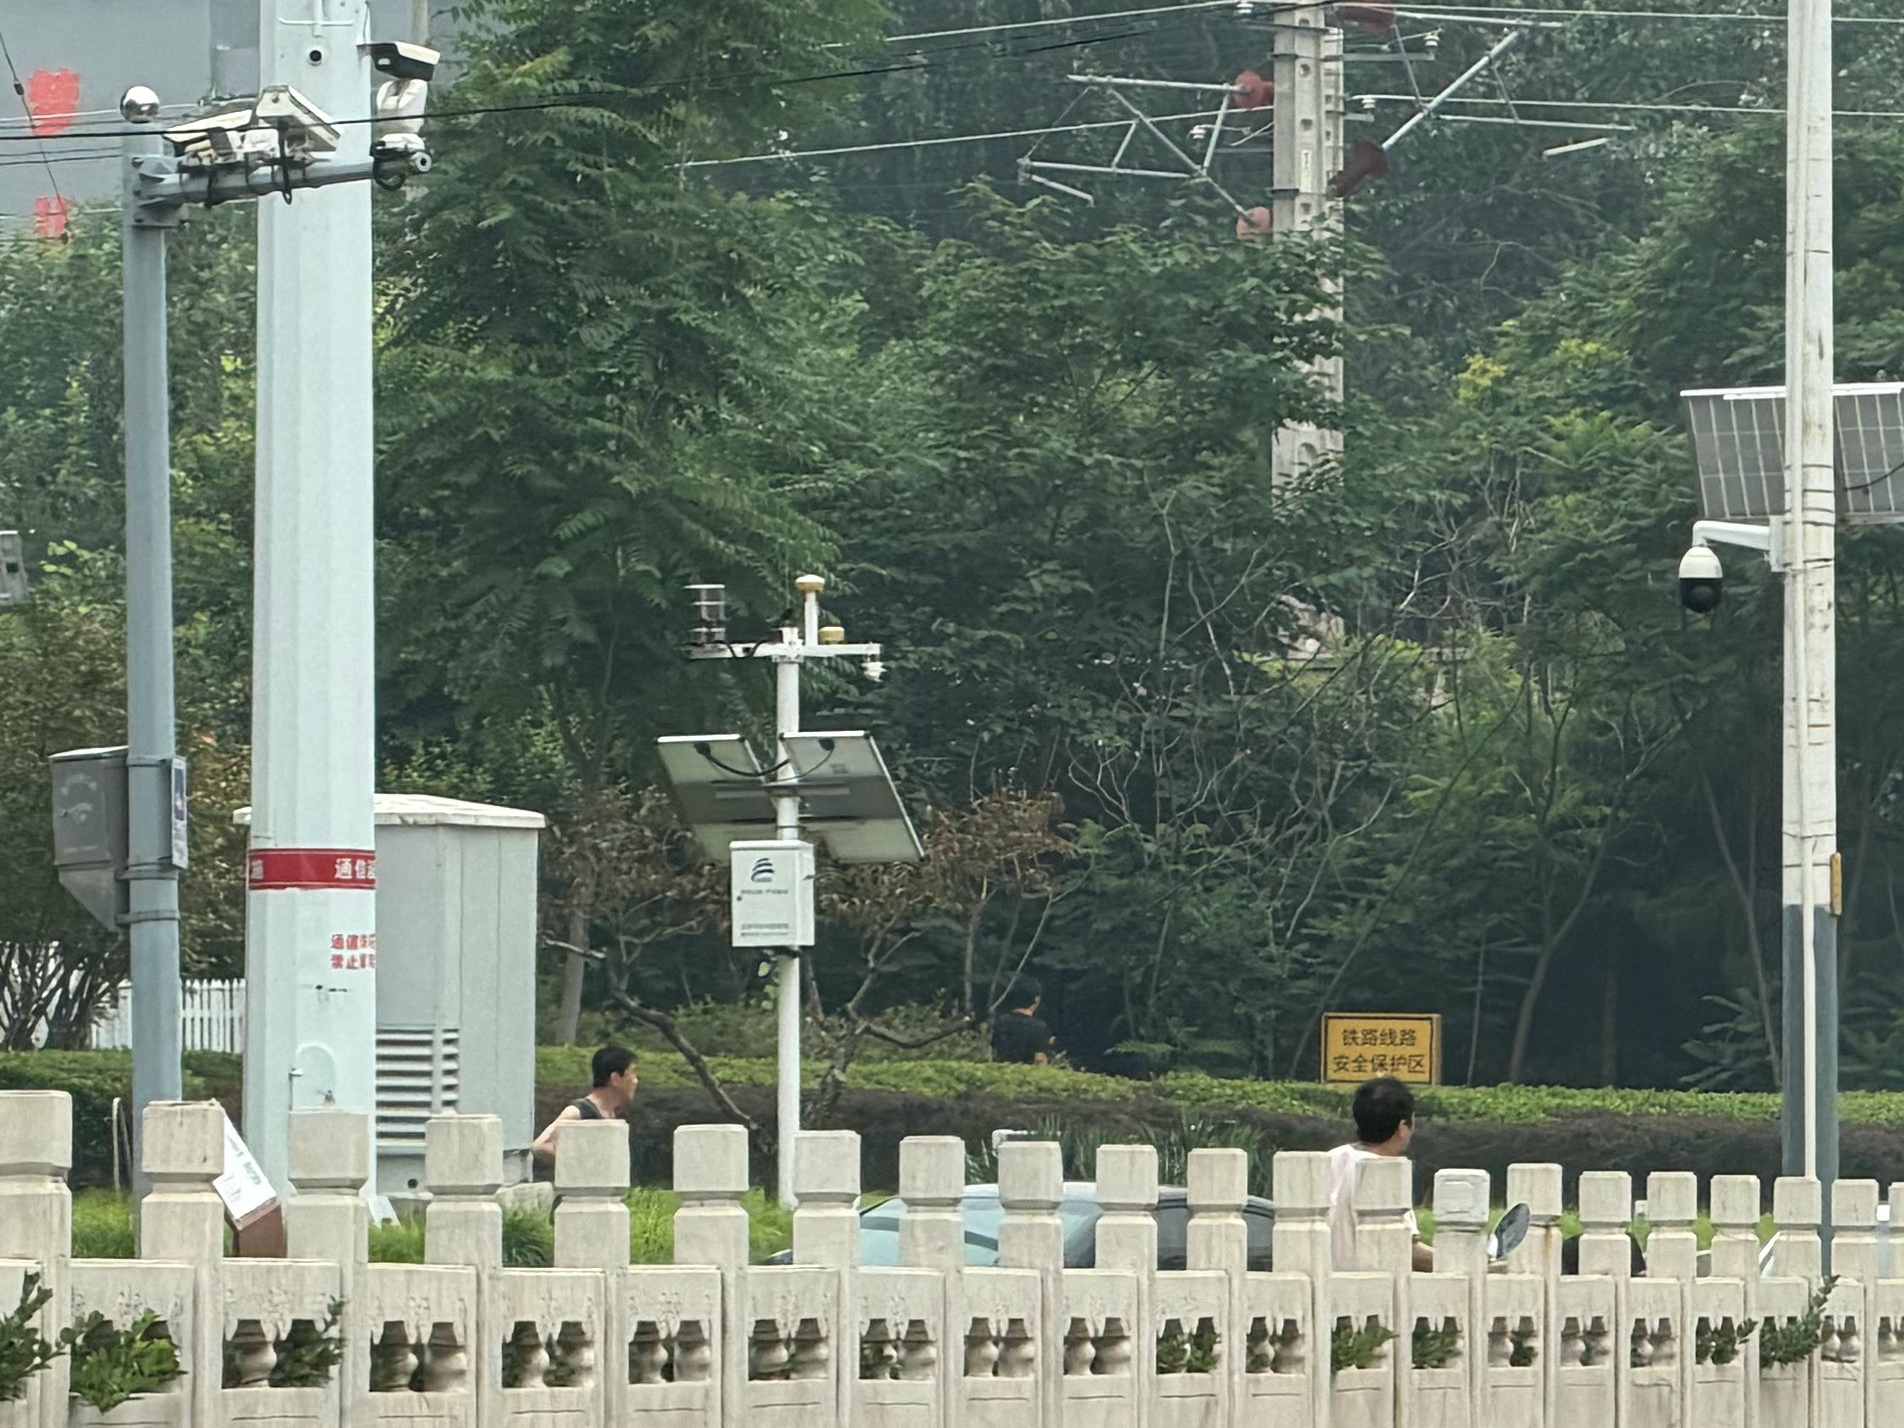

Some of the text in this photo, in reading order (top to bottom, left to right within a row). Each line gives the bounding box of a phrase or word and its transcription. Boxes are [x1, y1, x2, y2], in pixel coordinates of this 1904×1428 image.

[1342, 1028, 1417, 1047] 铁路线路
[1332, 1053, 1426, 1074] 安全保护区
